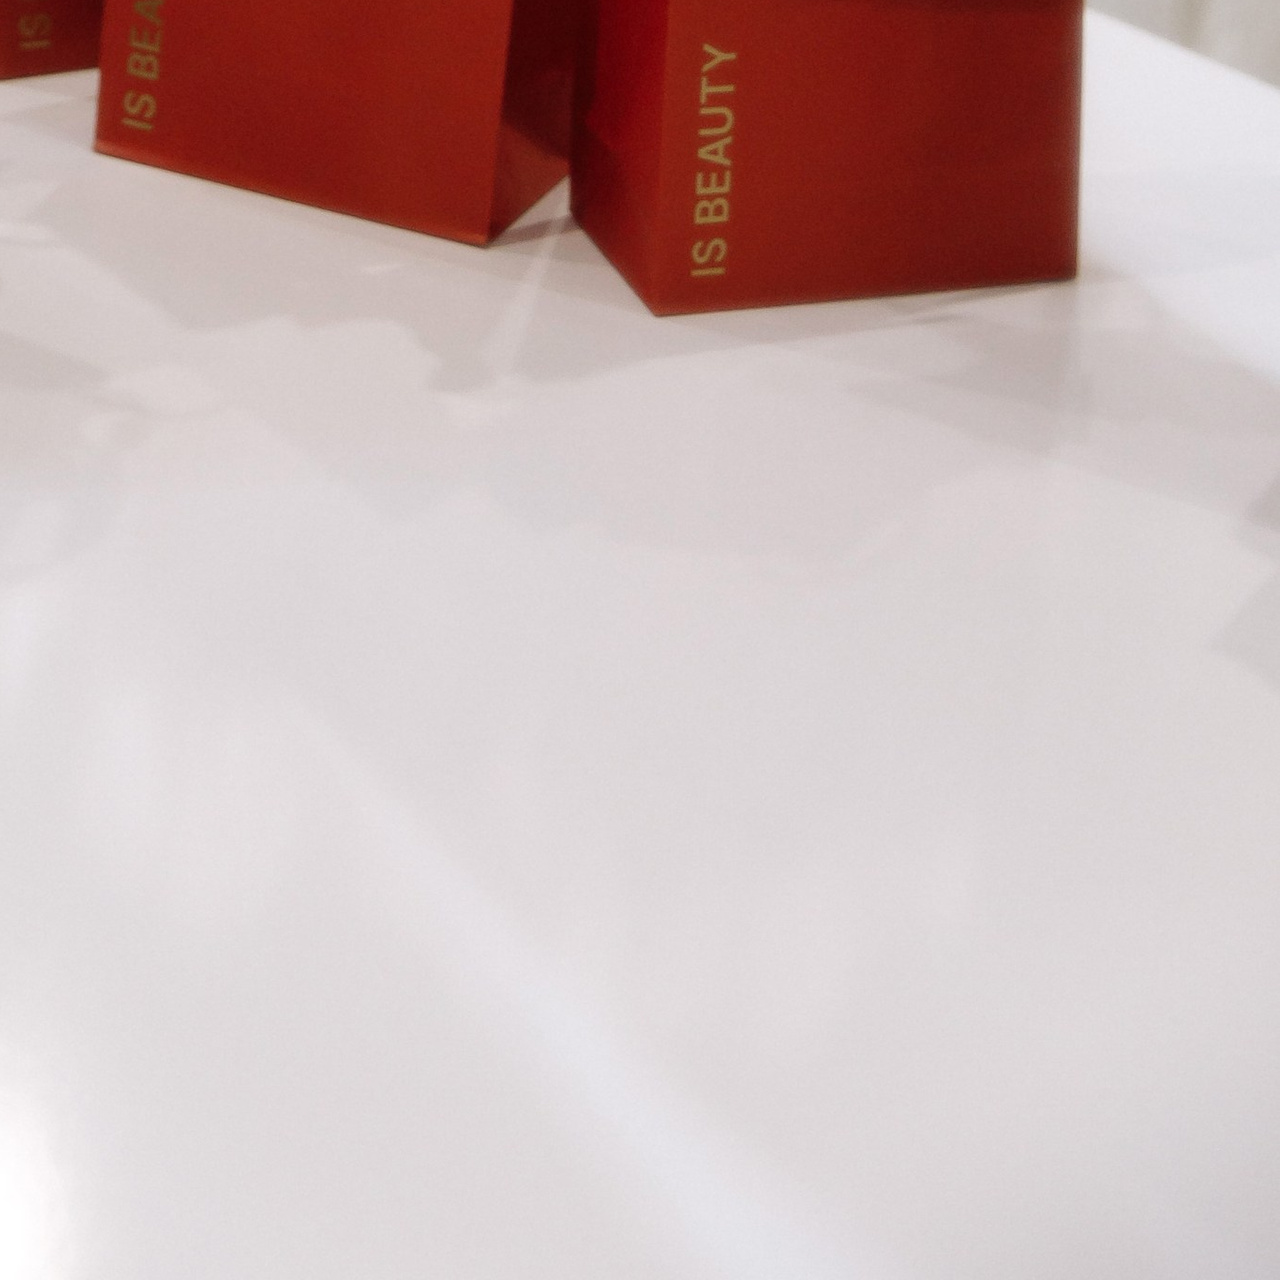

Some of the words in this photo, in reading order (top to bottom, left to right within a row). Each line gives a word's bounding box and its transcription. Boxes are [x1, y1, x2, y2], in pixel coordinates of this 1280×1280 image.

[20, 13, 52, 51] IS
[122, 90, 157, 132] IS
[694, 43, 738, 225] BEAUTY
[690, 237, 728, 278] IS
